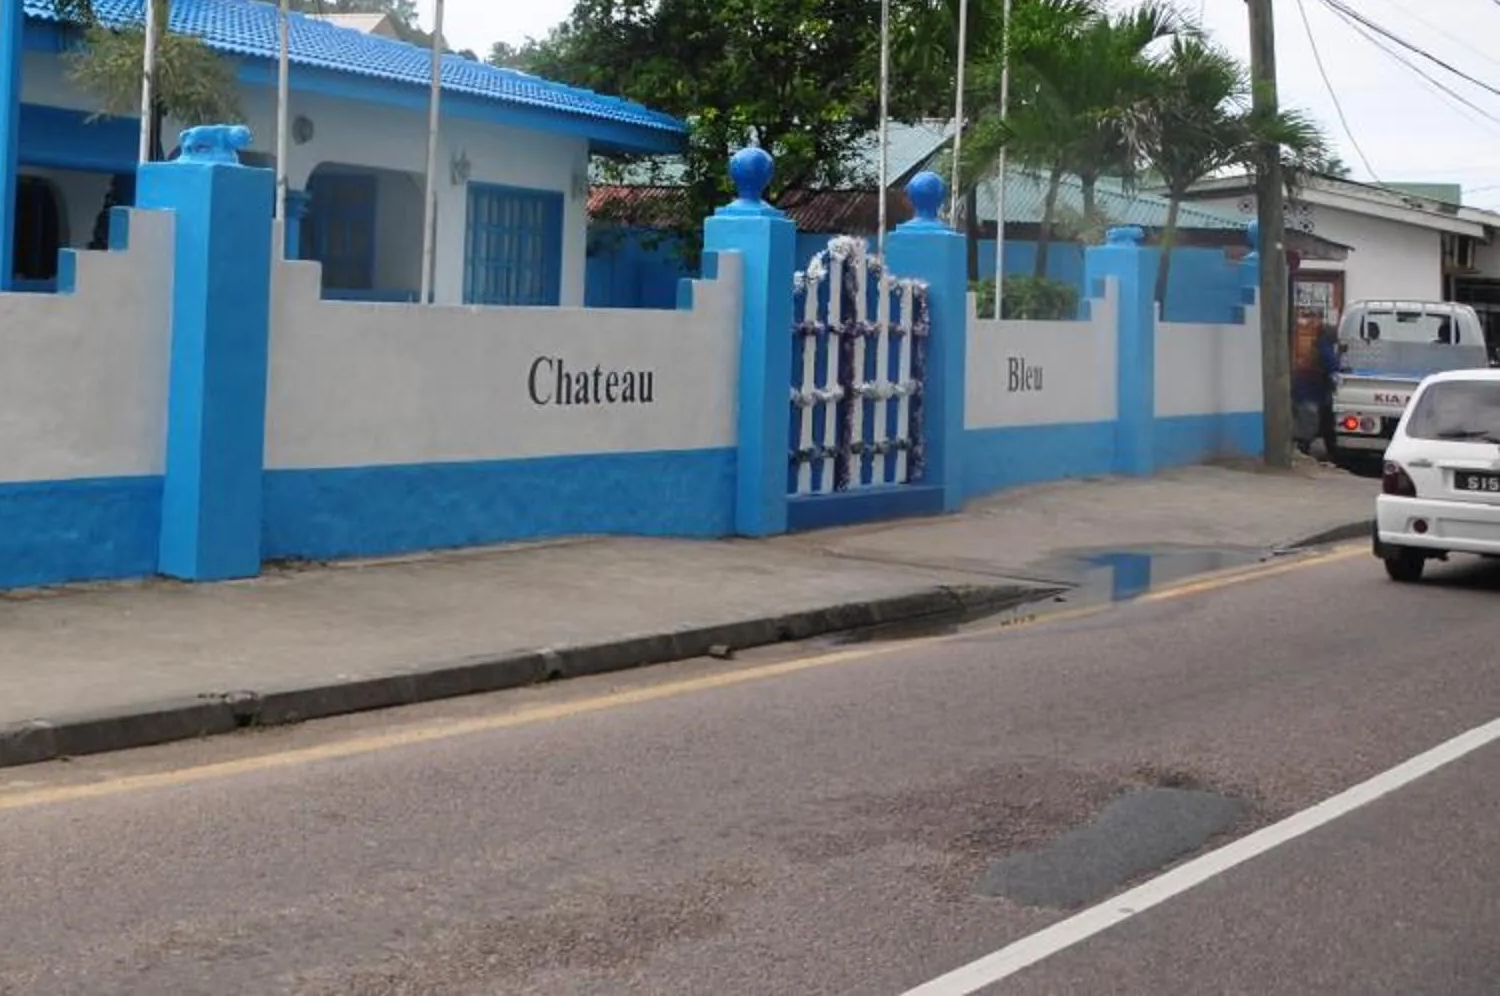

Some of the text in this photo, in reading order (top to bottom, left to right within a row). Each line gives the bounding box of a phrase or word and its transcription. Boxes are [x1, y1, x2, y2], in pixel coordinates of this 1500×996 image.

[528, 355, 653, 405] Chateau
[1007, 356, 1044, 392] Bleu
[1374, 392, 1400, 403] KIA
